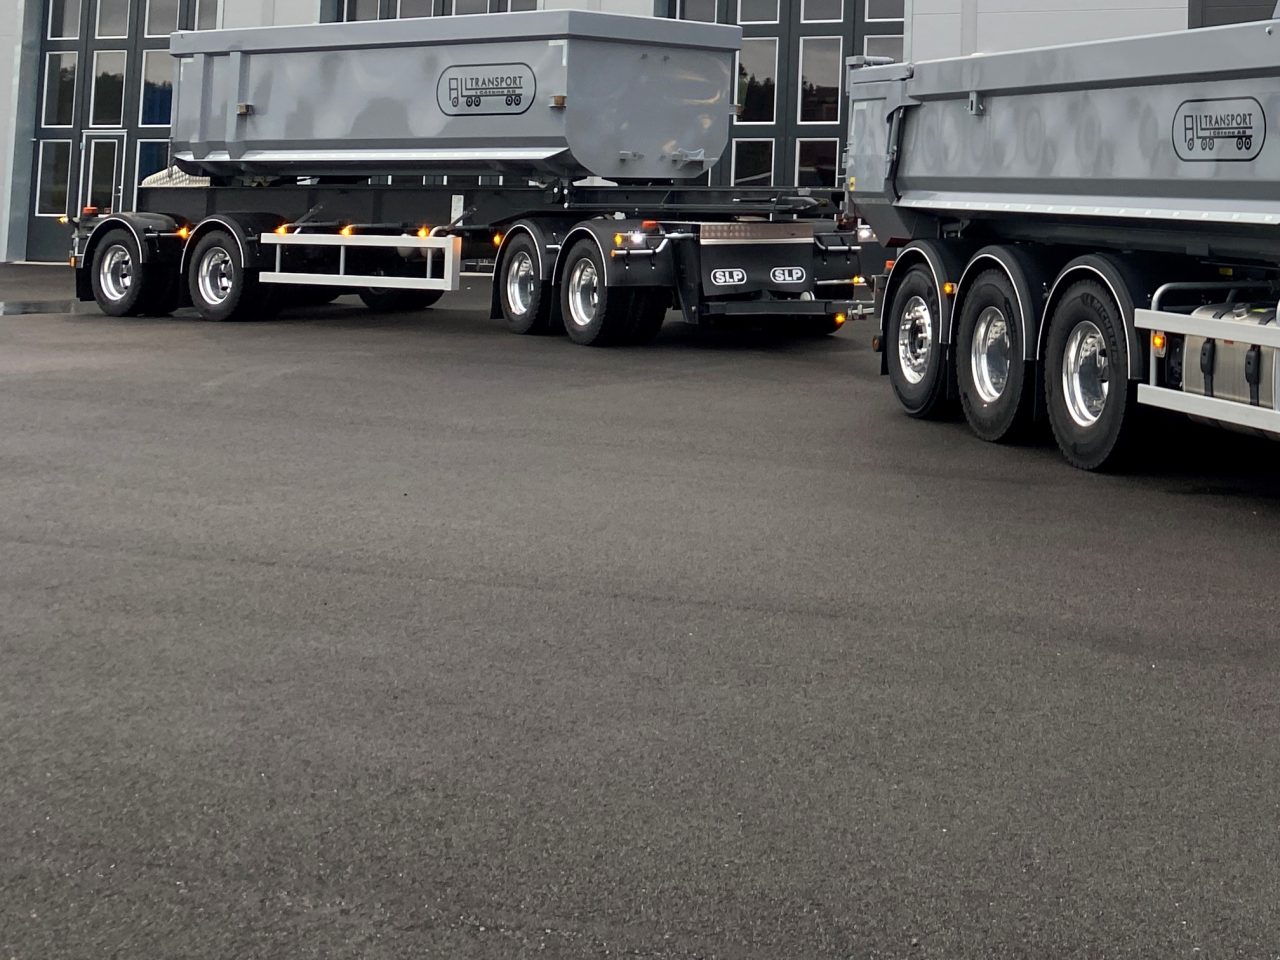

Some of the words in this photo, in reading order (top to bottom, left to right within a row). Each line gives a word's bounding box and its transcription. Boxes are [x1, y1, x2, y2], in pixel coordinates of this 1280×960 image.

[469, 76, 523, 88] TRANSPORT
[1204, 113, 1252, 126] TRANSPORT
[715, 271, 743, 283] SLP
[774, 269, 802, 281] SLP
